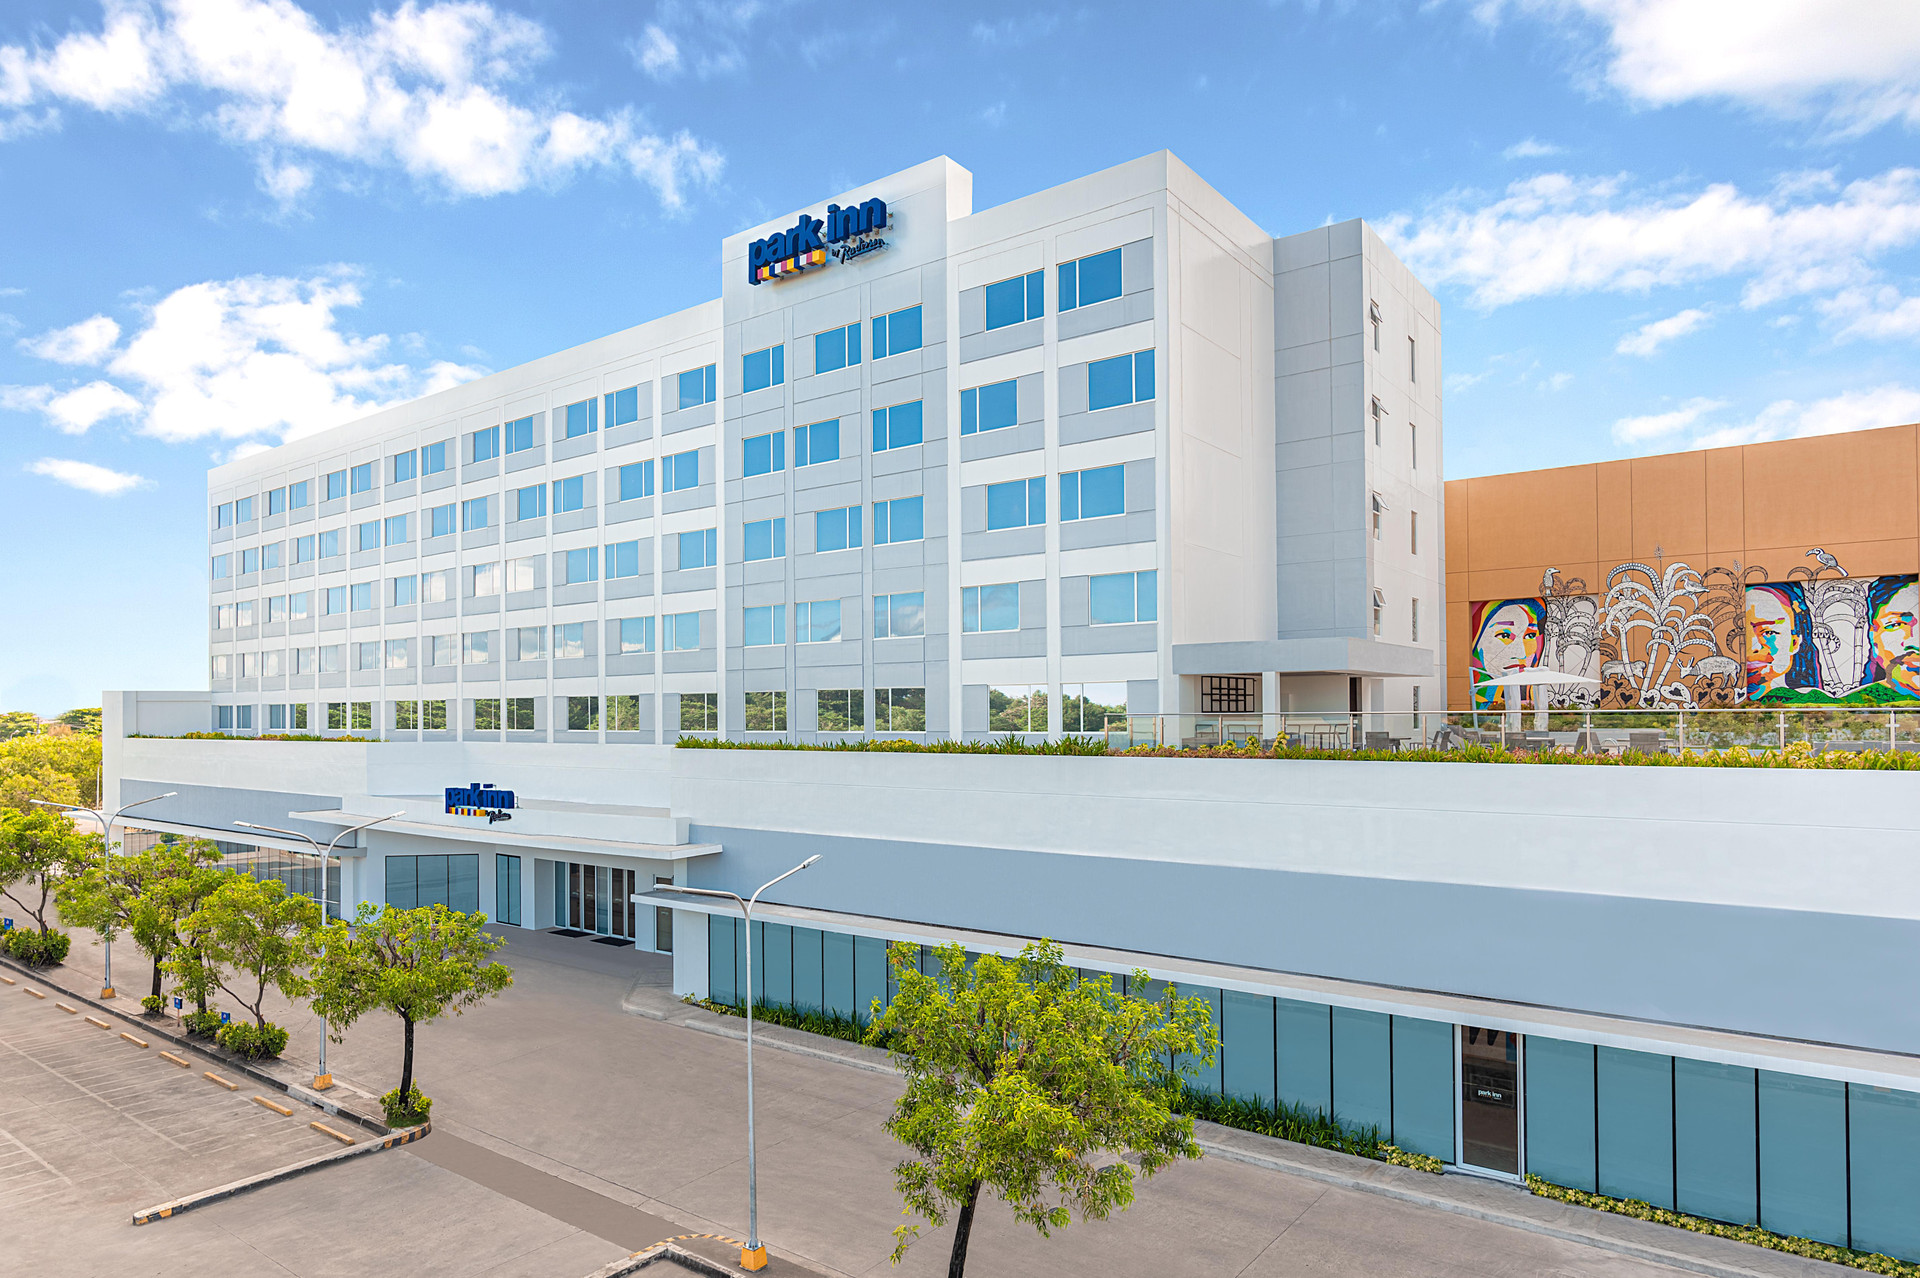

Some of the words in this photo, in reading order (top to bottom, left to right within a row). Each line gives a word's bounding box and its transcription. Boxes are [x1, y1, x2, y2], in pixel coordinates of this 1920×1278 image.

[749, 214, 824, 285] park
[827, 197, 887, 244] inn
[445, 783, 480, 813] park
[481, 784, 515, 809] inn
[1478, 1089, 1491, 1097] park
